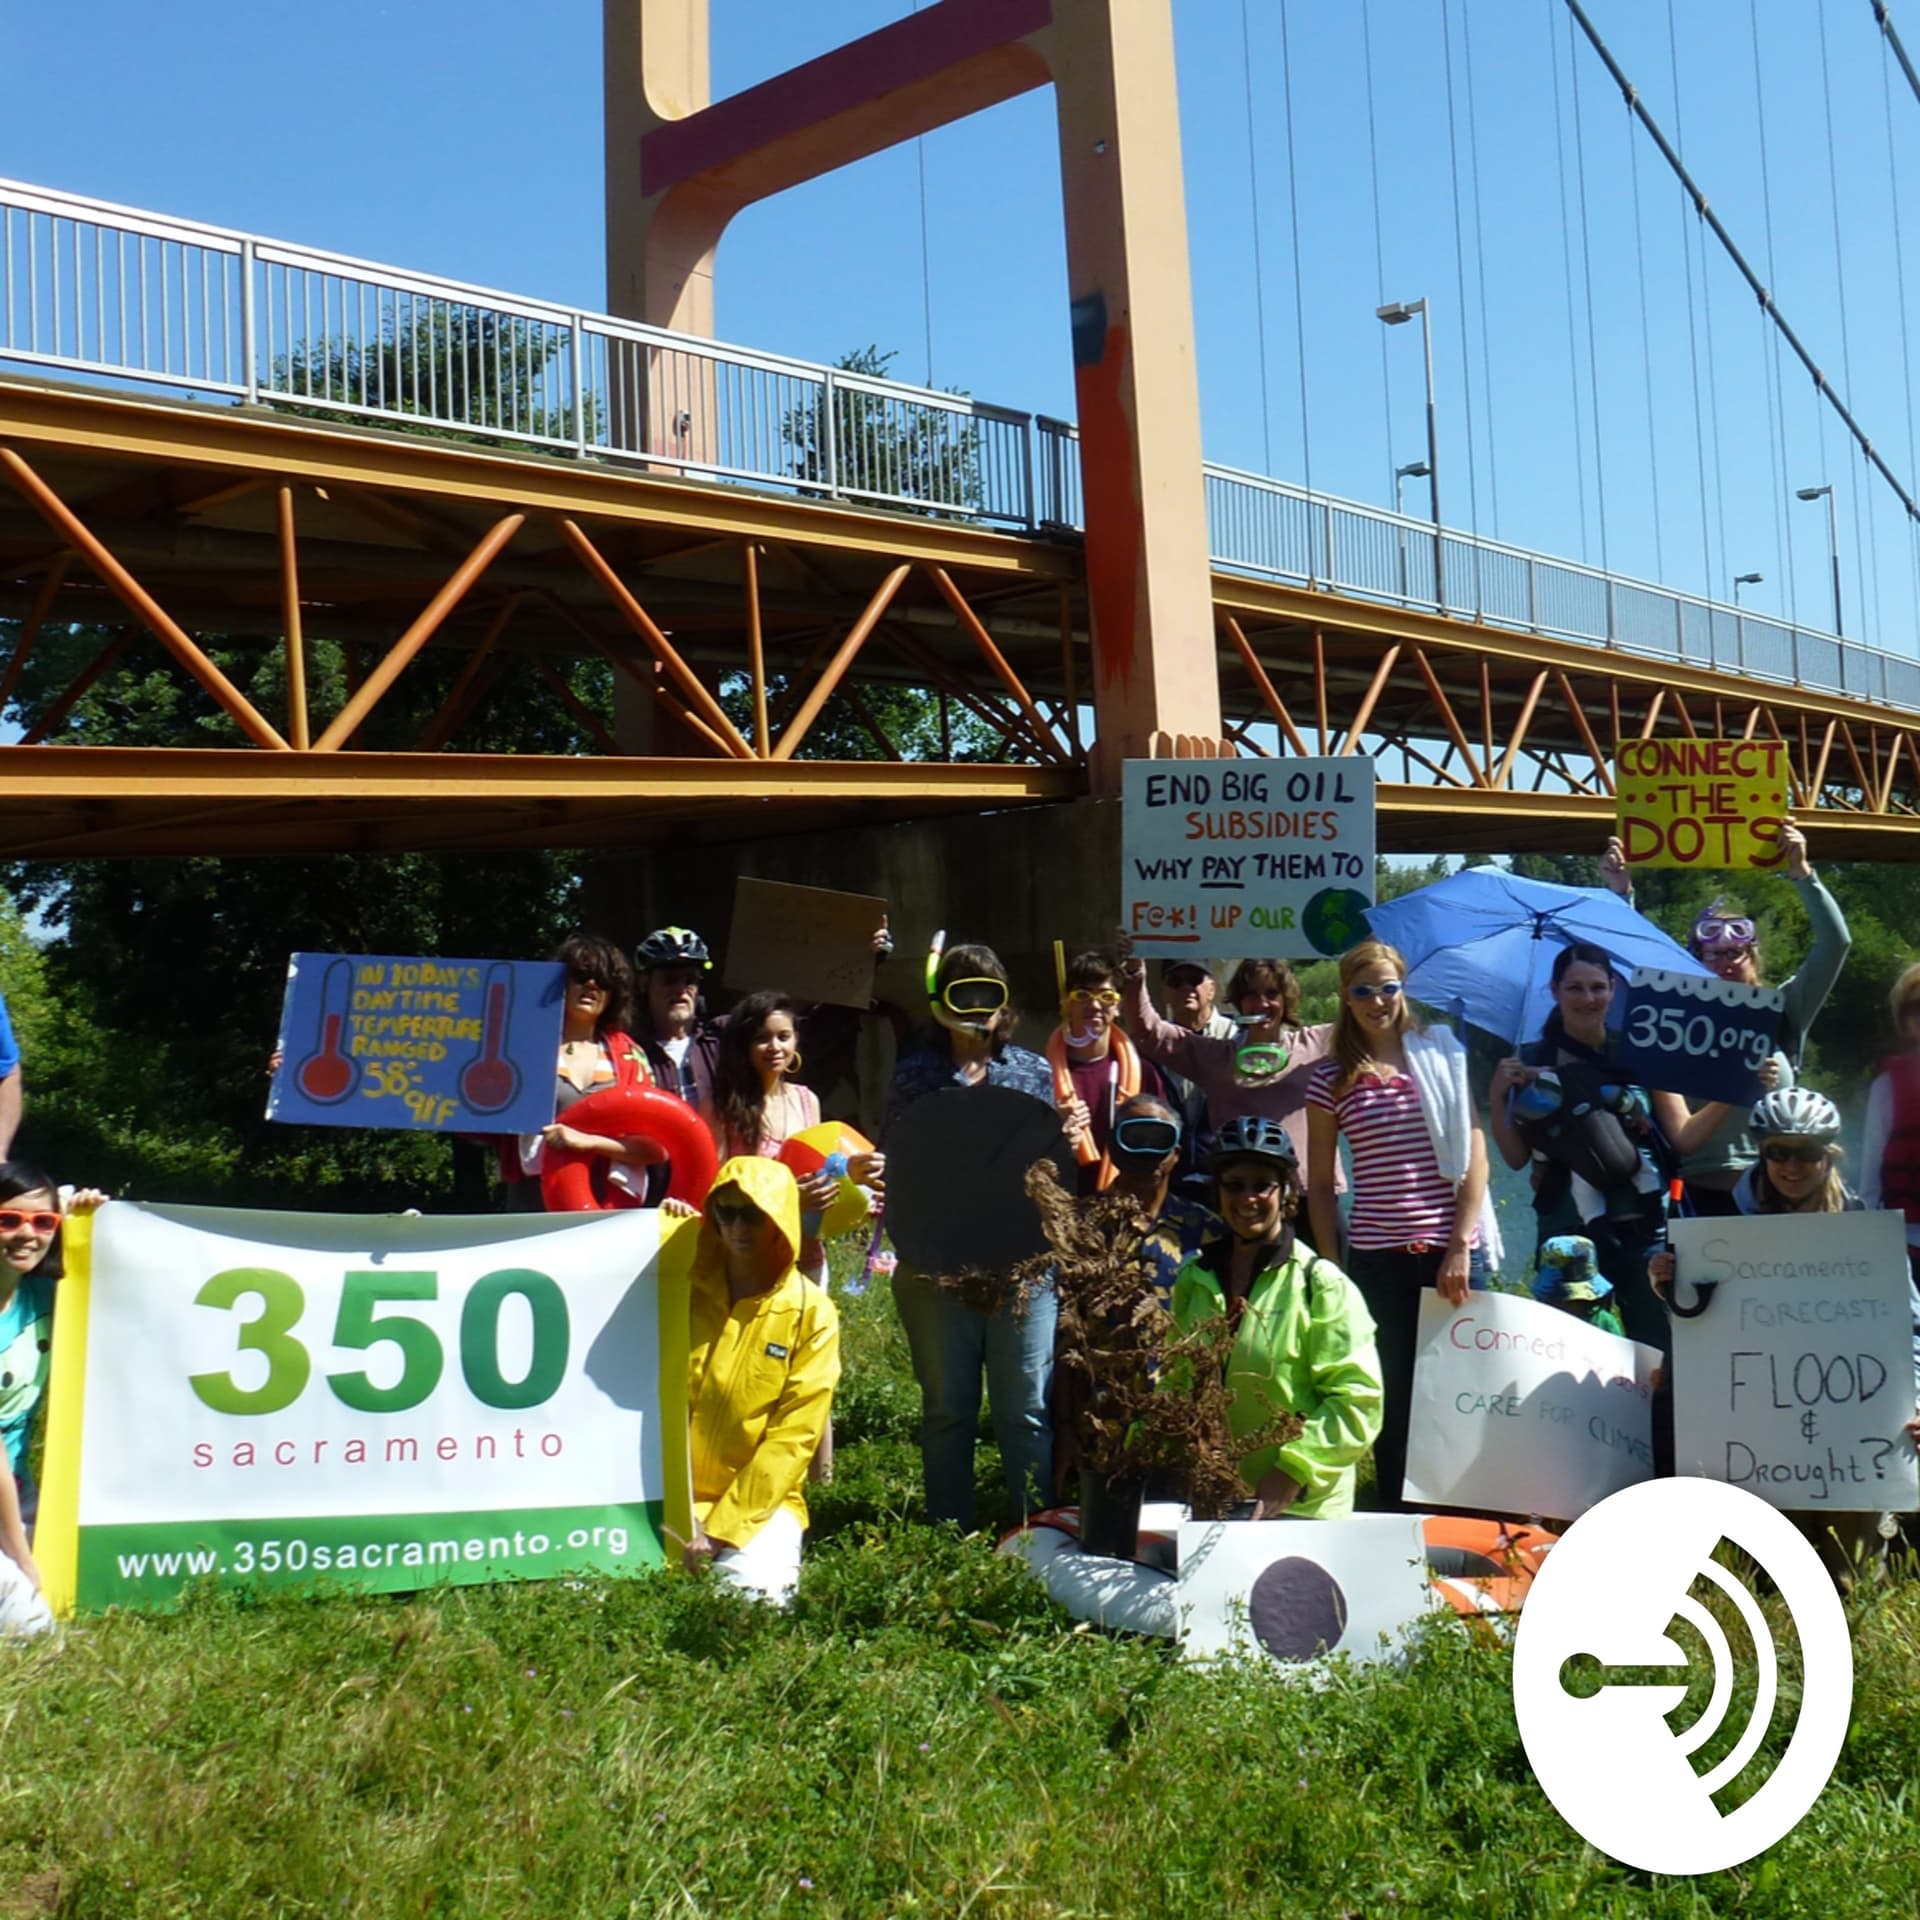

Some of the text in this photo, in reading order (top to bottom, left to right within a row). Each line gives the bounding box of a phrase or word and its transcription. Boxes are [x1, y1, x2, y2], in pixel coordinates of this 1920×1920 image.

[1618, 739, 1784, 779] CONNECT
[1146, 771, 1354, 807] END BIG OIL
[1659, 783, 1738, 814] THE
[1185, 811, 1339, 840] SUBSIDIES
[1623, 816, 1786, 867] DOTS
[1134, 852, 1363, 880] WHY PAY THEM TO
[1210, 904, 1242, 929] UP
[1250, 906, 1295, 929] OUR
[351, 1035, 447, 1062] RANGED
[1627, 1004, 1771, 1071] 350.org
[1702, 1239, 1872, 1282] Sacramento
[188, 1267, 571, 1417] 350
[1450, 1317, 1566, 1361] Connect
[1731, 1352, 1887, 1412] FLOOD
[1455, 1392, 1521, 1417] CARE
[193, 1428, 565, 1468] sacramento
[117, 1525, 629, 1579] www.350sacramento.org
